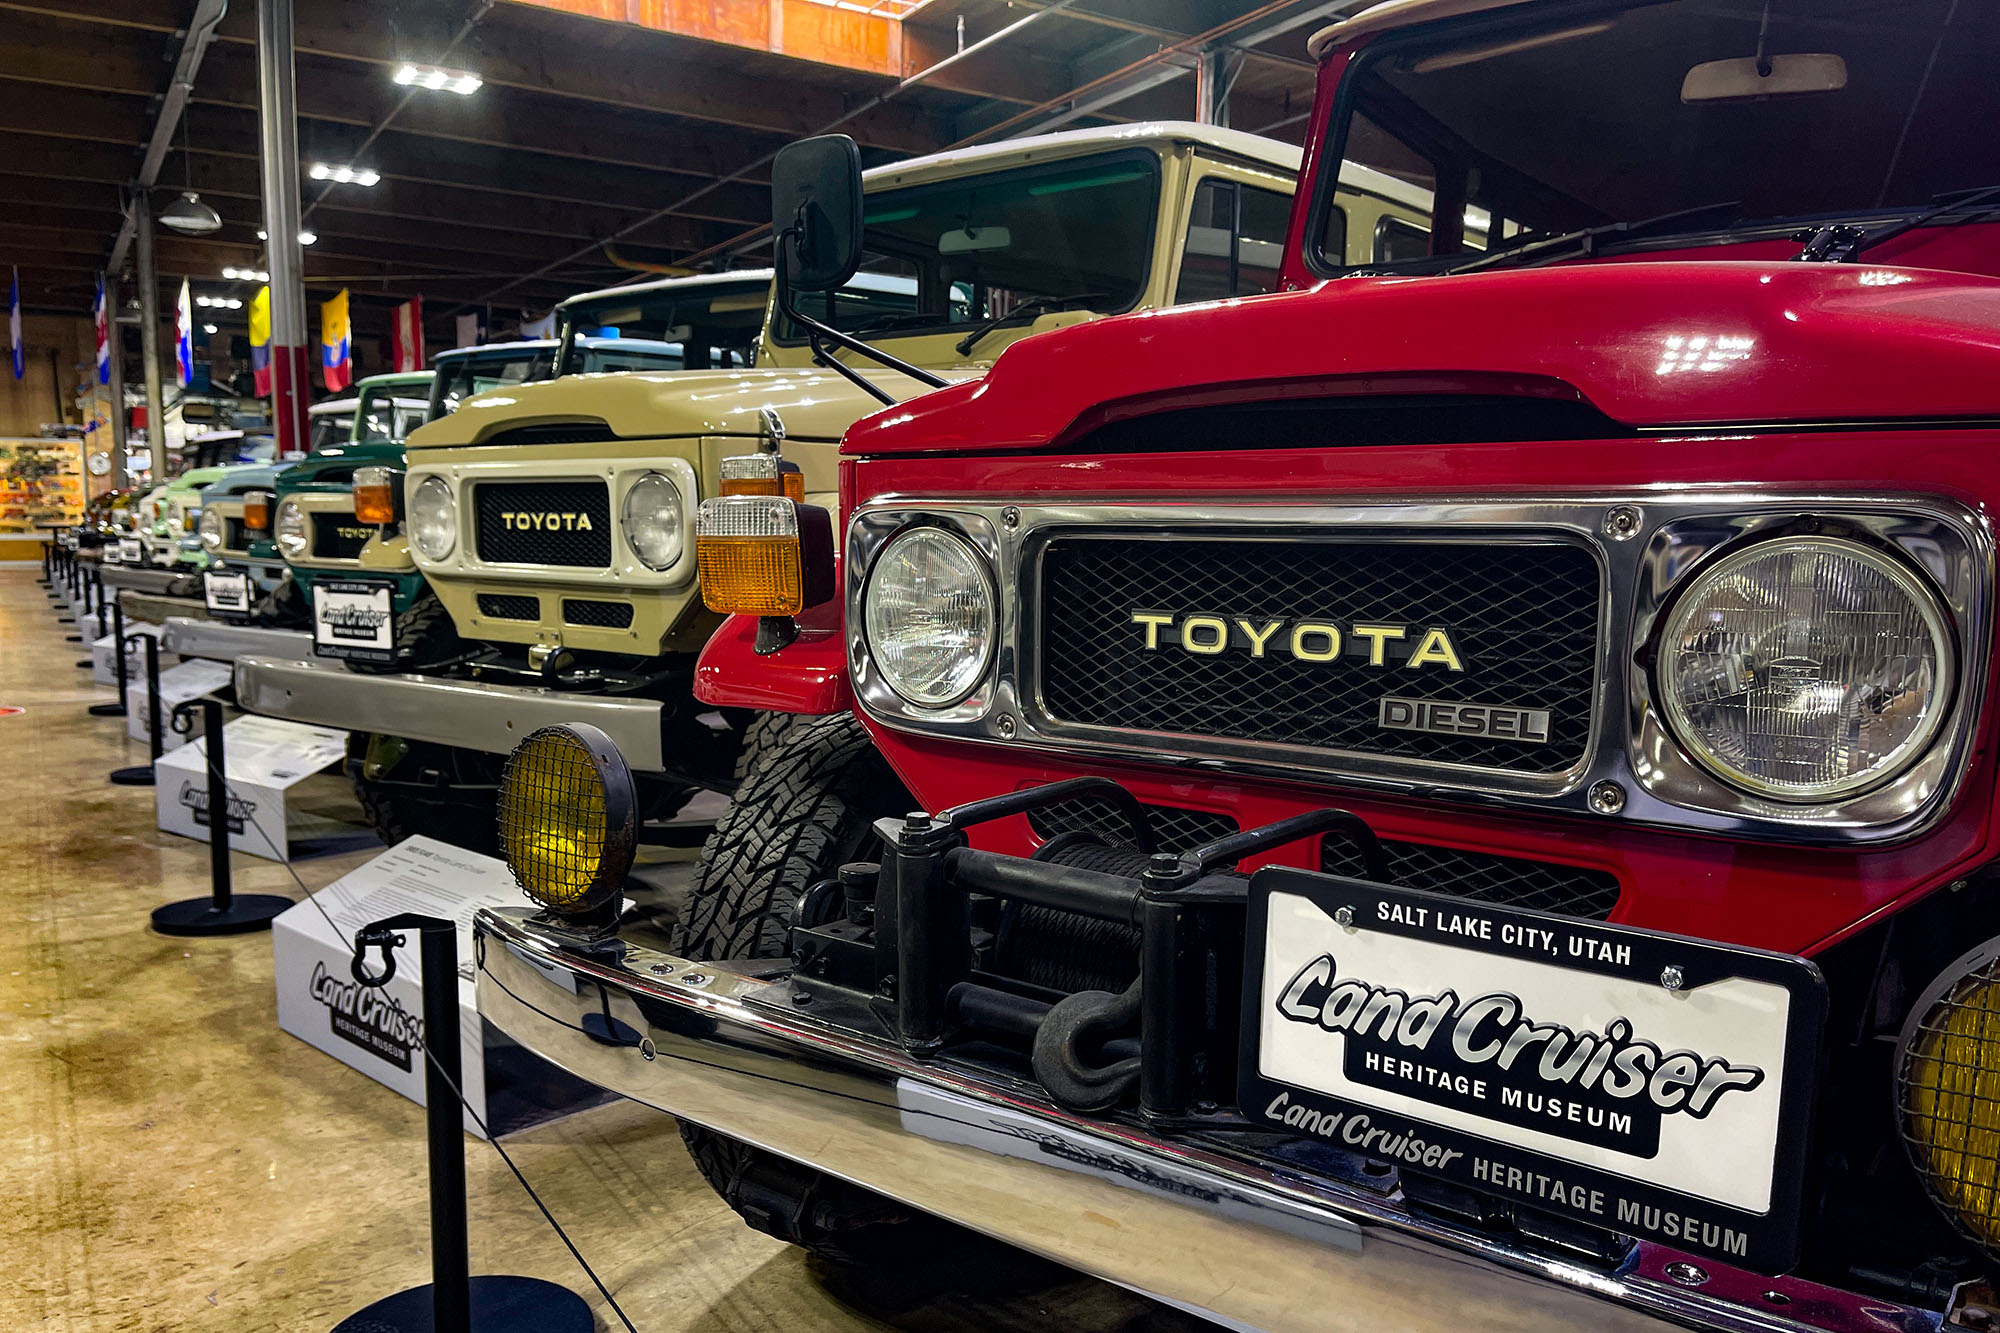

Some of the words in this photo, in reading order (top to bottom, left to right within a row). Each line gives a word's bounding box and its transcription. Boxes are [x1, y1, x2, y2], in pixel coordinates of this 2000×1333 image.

[336, 527, 379, 539] TOYOT
[501, 512, 593, 531] TOYOTA
[320, 602, 346, 626] Land
[346, 604, 390, 628] Cruiser
[1131, 608, 1467, 673] TOYOTA
[1382, 698, 1548, 743] DIESEL
[1377, 901, 1428, 928] SALT
[1436, 912, 1493, 941] LAKE
[1501, 923, 1558, 956] CITY,
[1569, 936, 1632, 966] UTAH
[310, 961, 357, 1015] Land
[335, 1015, 370, 1041] HERITAGE
[371, 1034, 407, 1061] MUSEUM
[1278, 954, 1456, 1052] Land
[1452, 991, 1766, 1117] Cruiser
[1365, 1051, 1487, 1100] HERITAGE
[1502, 1086, 1633, 1135] MUSEUM
[1265, 1091, 1343, 1137] Land
[1342, 1114, 1463, 1169] Cruiser
[1473, 1158, 1605, 1214] HERITAGE
[1617, 1198, 1748, 1258] MUSEUM
